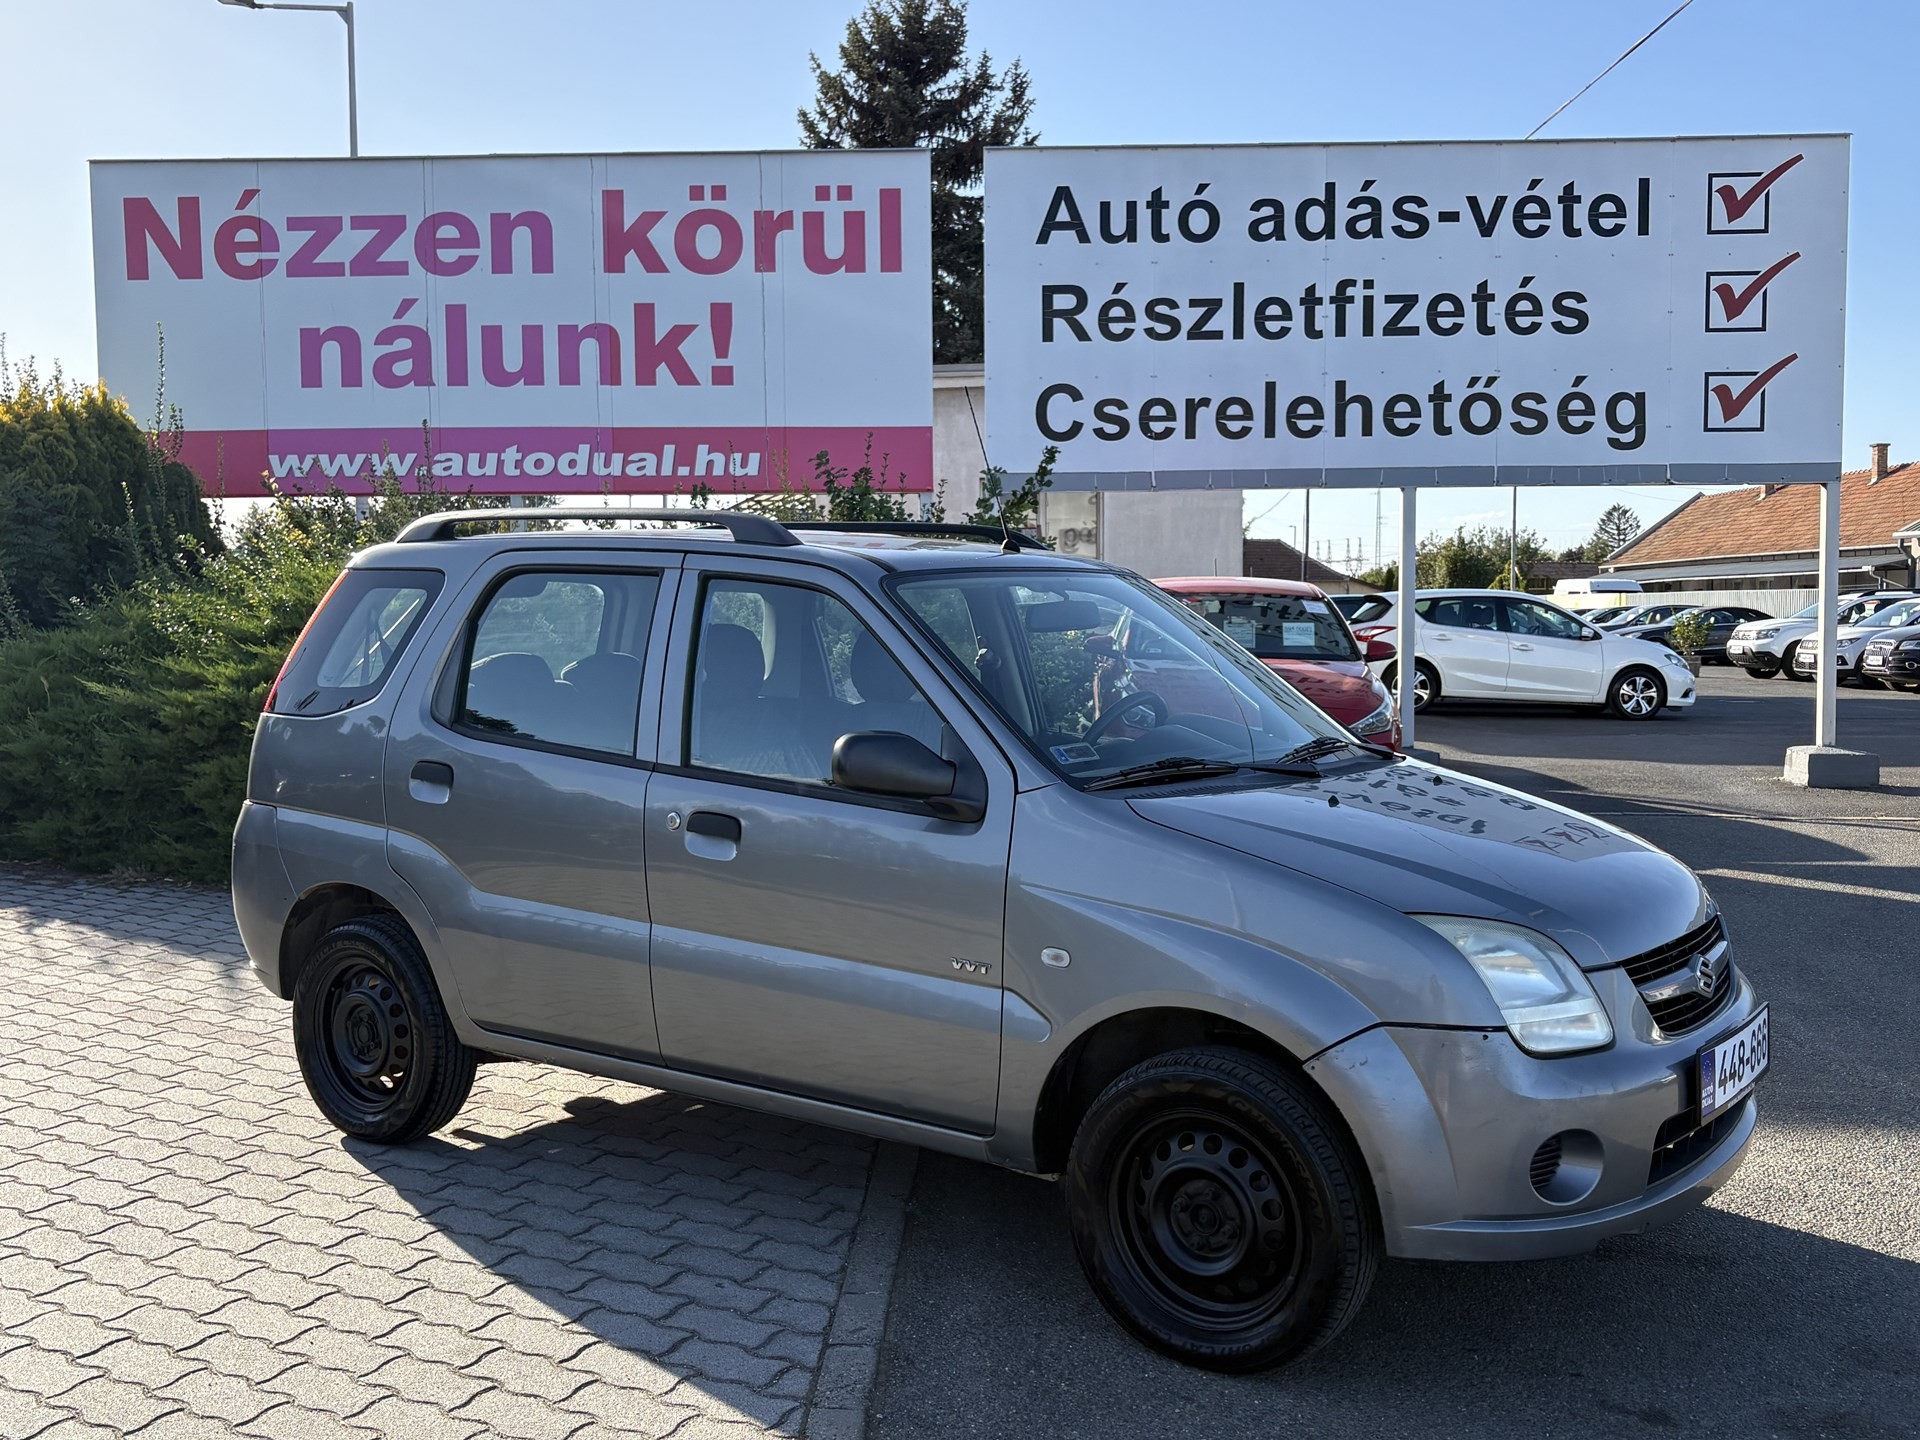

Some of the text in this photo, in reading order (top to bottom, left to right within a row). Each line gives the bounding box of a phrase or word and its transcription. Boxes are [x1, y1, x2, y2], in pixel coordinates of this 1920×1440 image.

[122, 184, 902, 280] Nézzen körül
[1035, 177, 1651, 245] Autó adás-vétel
[300, 298, 735, 388] nálunk!
[1041, 275, 1591, 343] Részletfizetés
[1035, 375, 1647, 451] Cserelehetőség
[268, 444, 761, 479] www.autodual.hu
[950, 956, 992, 975] VVT
[1717, 1017, 1767, 1096] 448-666
